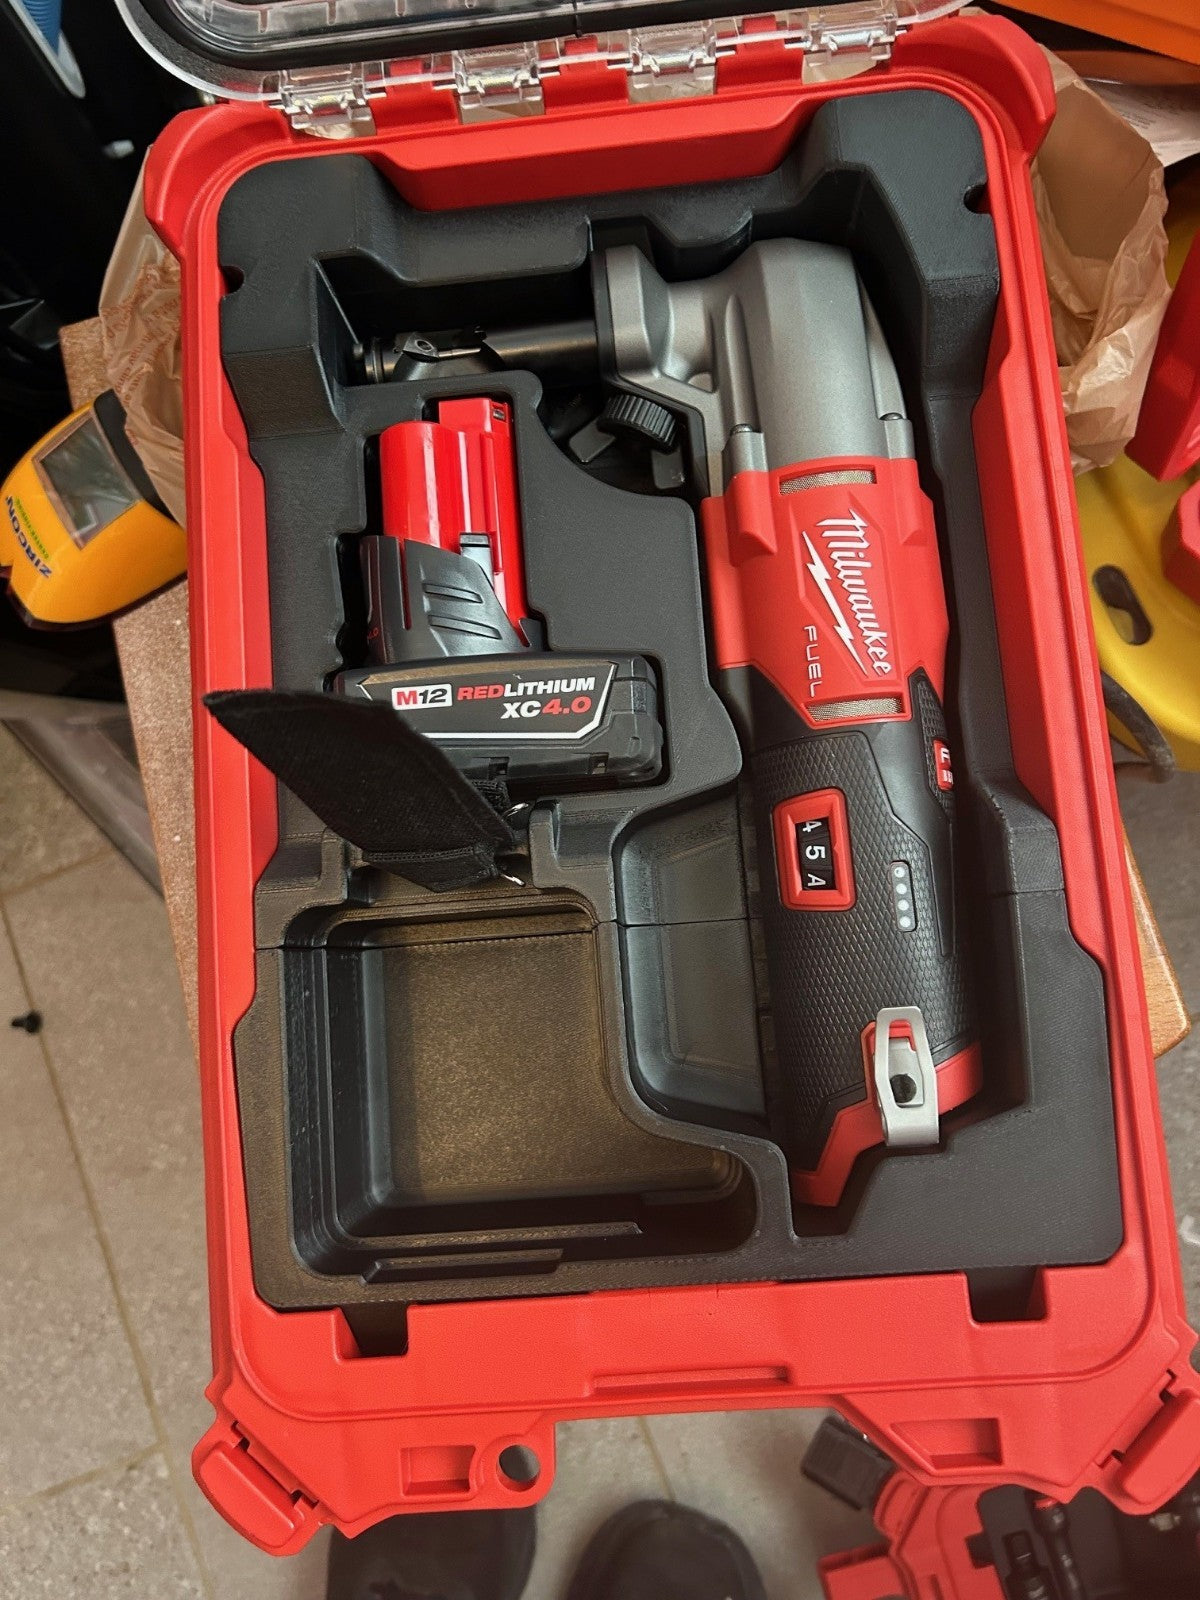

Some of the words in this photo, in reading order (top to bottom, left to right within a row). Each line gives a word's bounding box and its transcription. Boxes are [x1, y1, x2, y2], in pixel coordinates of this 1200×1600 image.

[6, 496, 51, 578] ZIRCON
[815, 508, 892, 677] Milwaukee
[804, 626, 822, 698] FUEL
[396, 689, 447, 705] M12
[457, 677, 595, 700] REDLITHIUM
[803, 821, 822, 833] 4
[806, 845, 826, 860] 5
[808, 873, 826, 888] A
